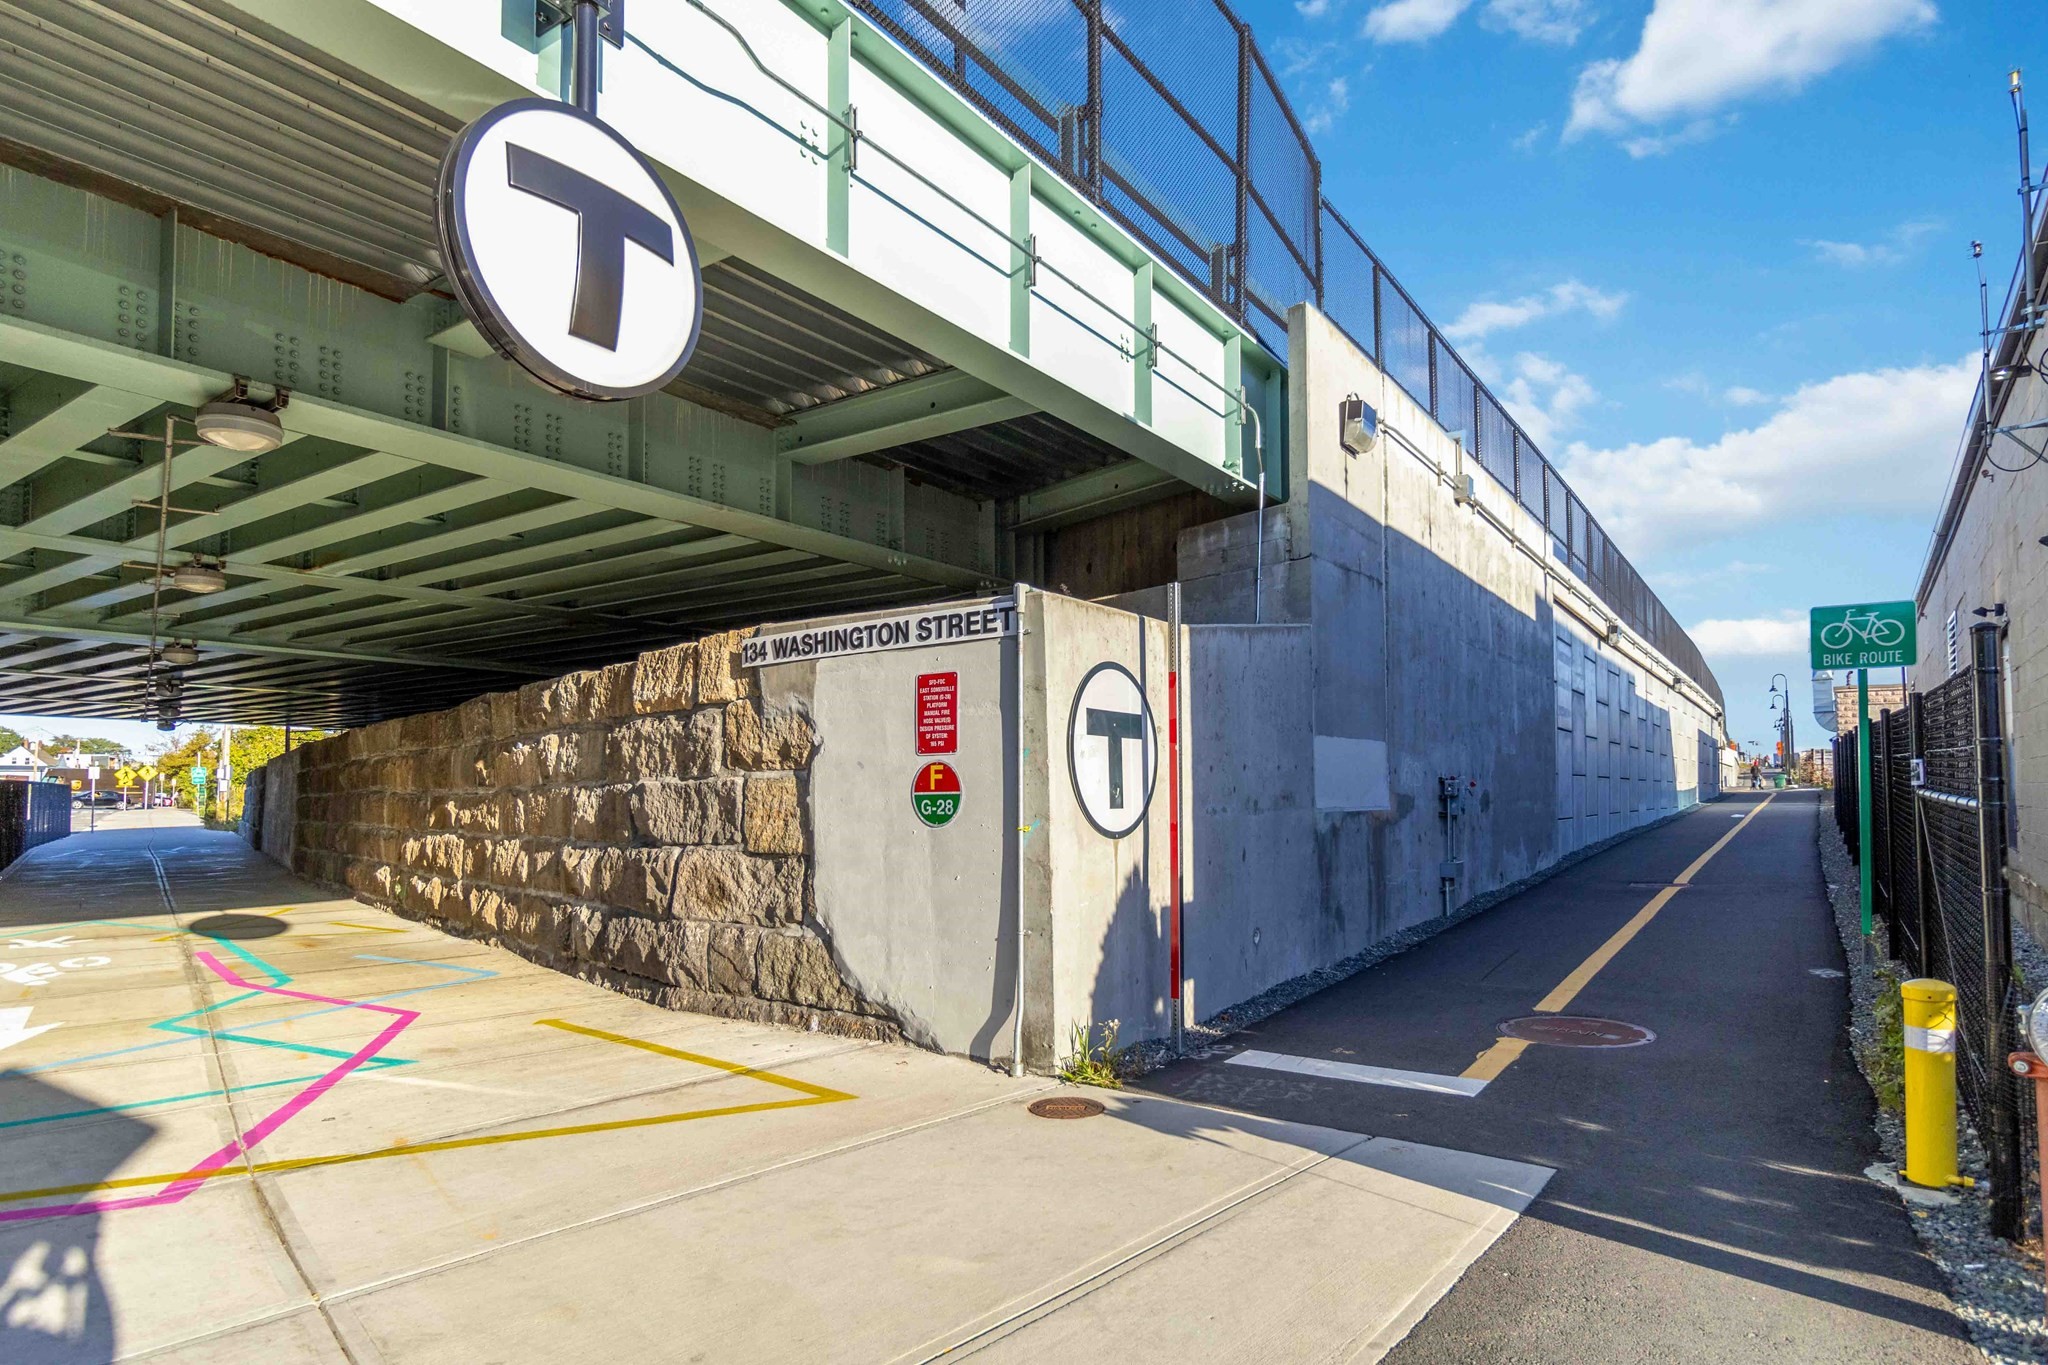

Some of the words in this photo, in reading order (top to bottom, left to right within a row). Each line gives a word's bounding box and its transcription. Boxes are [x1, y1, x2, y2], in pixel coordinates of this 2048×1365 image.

[505, 141, 675, 352] T
[743, 640, 768, 664] 134
[771, 619, 910, 660] WASHINGTON
[916, 606, 1018, 640] STREET
[1823, 652, 1853, 666] BIKE
[1859, 650, 1903, 664] ROUTE
[930, 685, 955, 693] SOMERVILLE
[1086, 707, 1144, 809] T
[929, 764, 944, 790] F
[921, 799, 954, 815] G-28
